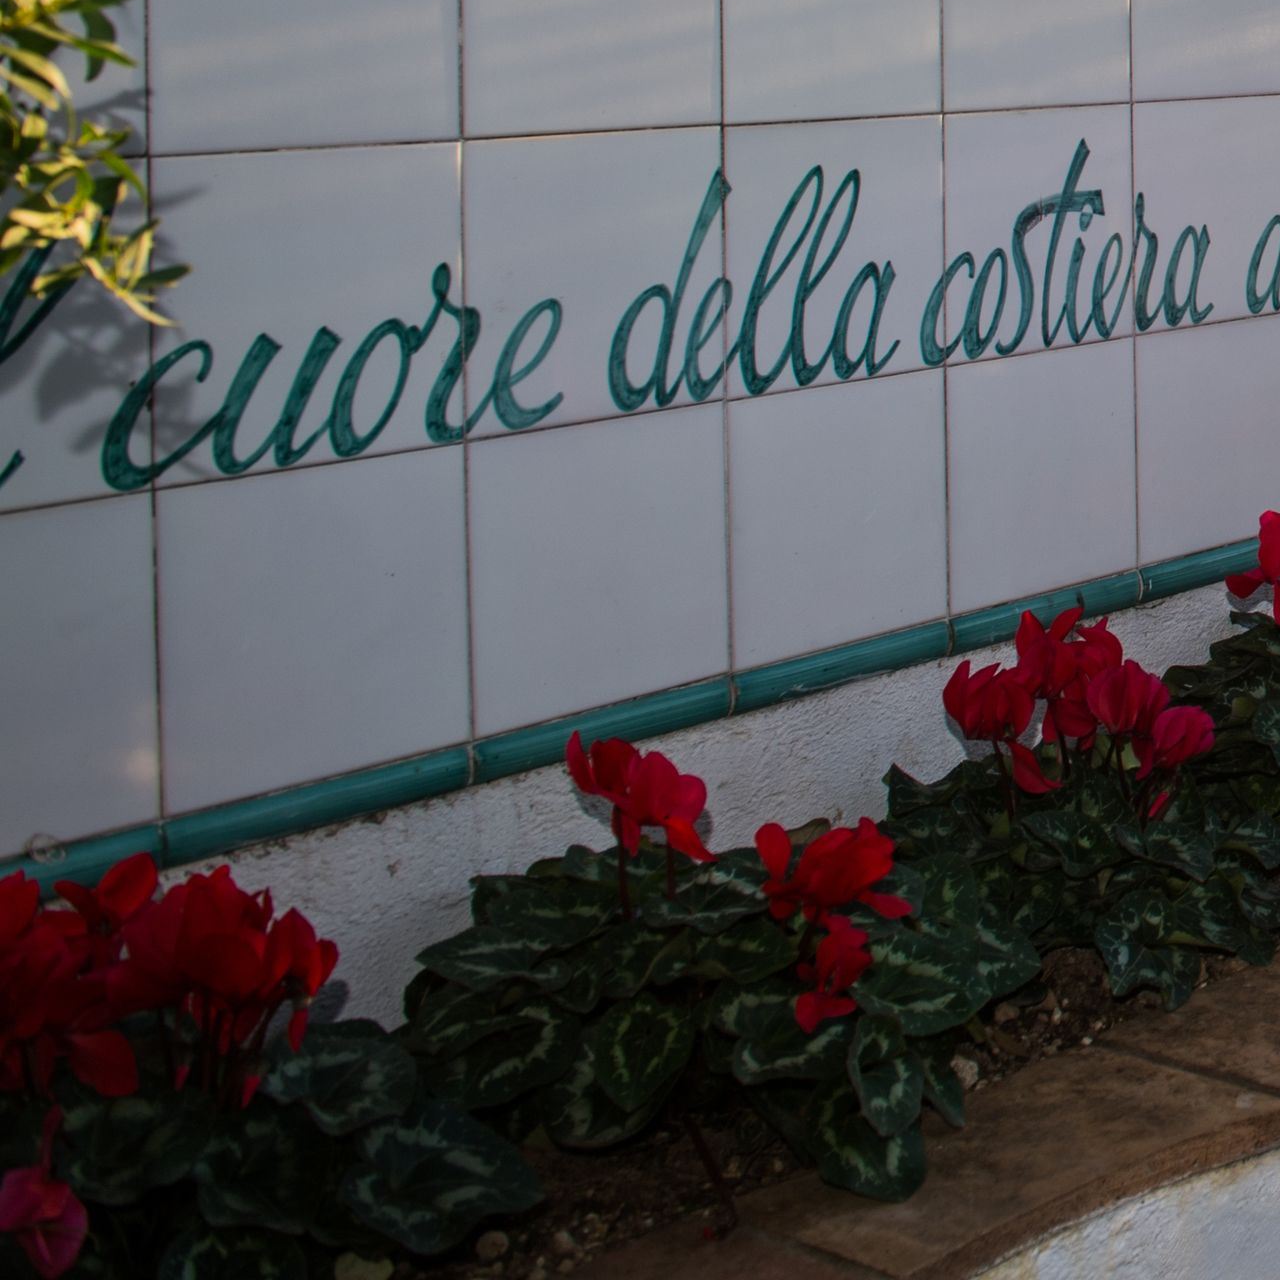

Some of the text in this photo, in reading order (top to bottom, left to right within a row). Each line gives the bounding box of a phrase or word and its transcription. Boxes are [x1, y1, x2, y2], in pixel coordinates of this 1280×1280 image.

[101, 261, 564, 493] cuore
[608, 164, 902, 413] della
[918, 136, 1215, 368] costiera
